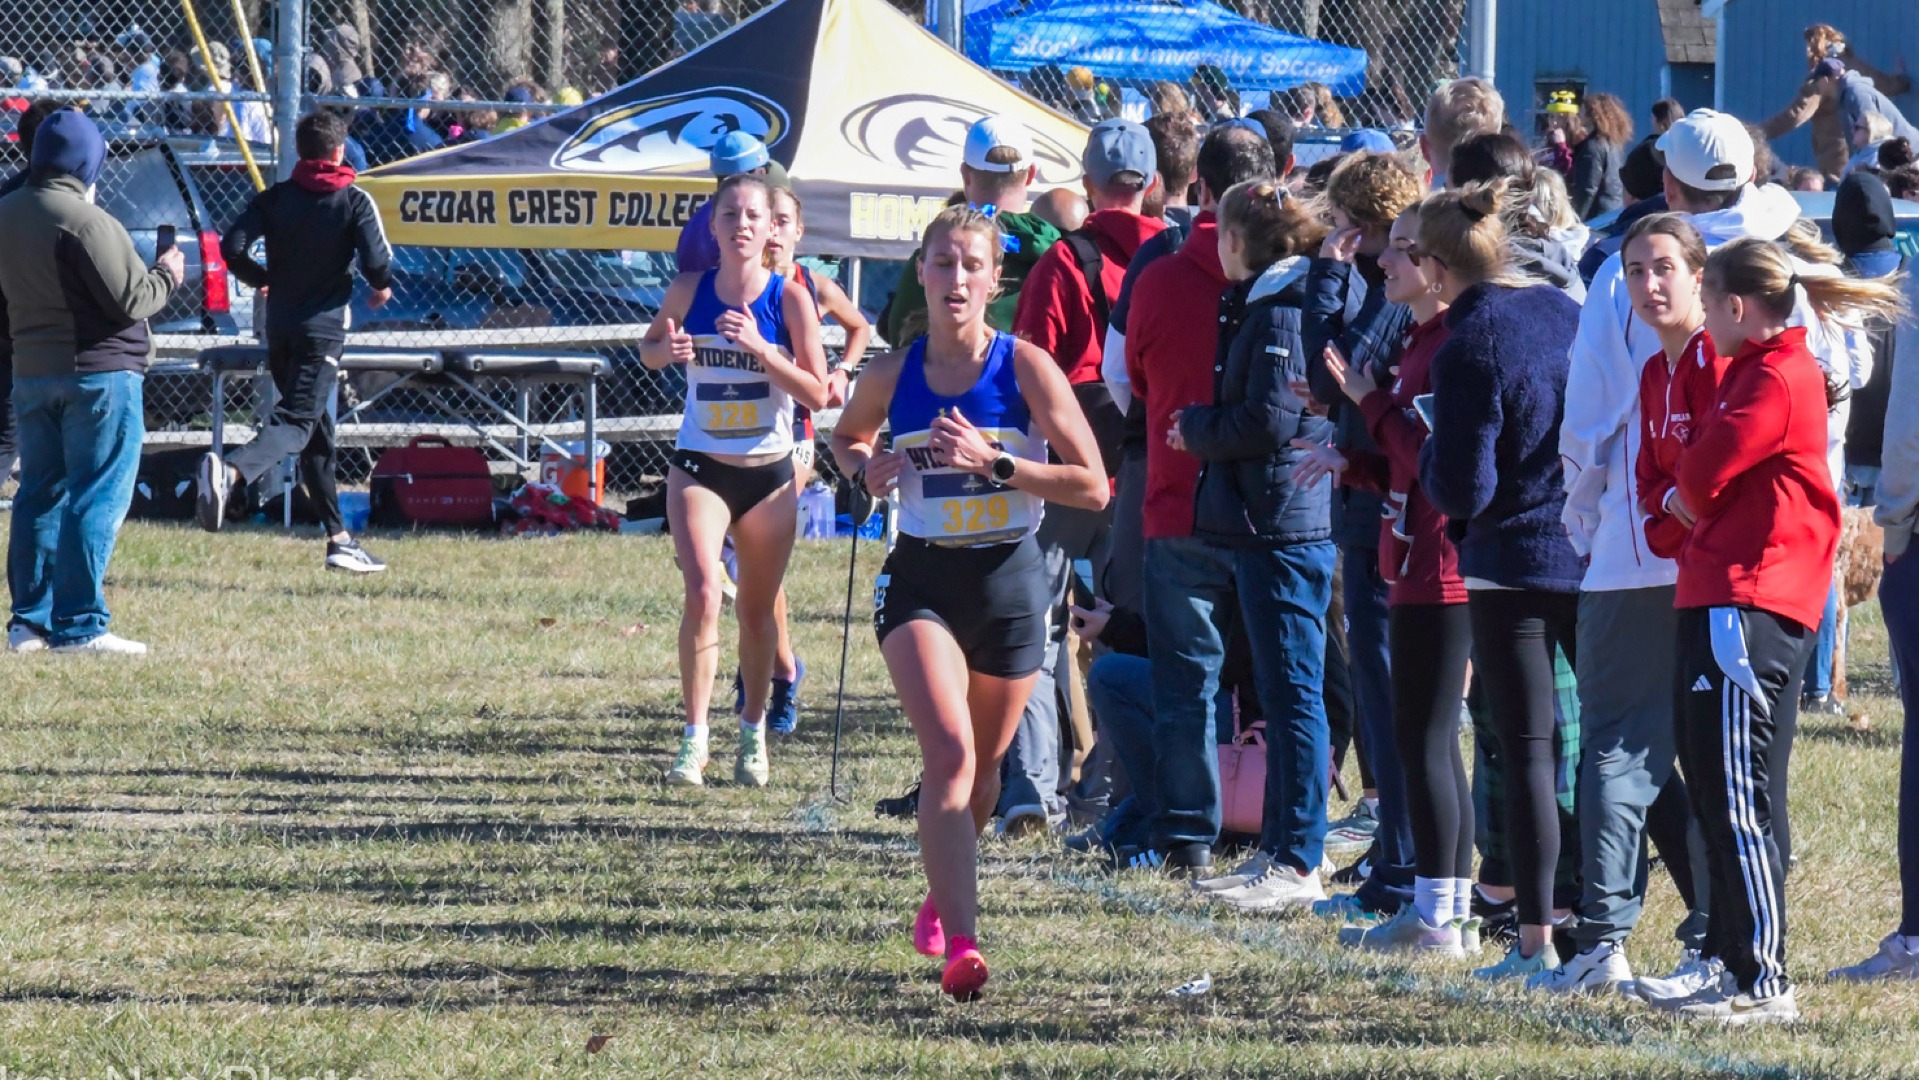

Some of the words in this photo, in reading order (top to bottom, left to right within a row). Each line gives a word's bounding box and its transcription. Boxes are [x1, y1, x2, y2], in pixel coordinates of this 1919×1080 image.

[1260, 52, 1342, 78] Soccer
[399, 189, 497, 224] CEDAR
[507, 189, 599, 226] CREST
[607, 190, 715, 228] COLLEG
[707, 402, 758, 429] 328
[943, 495, 1010, 534] 329
